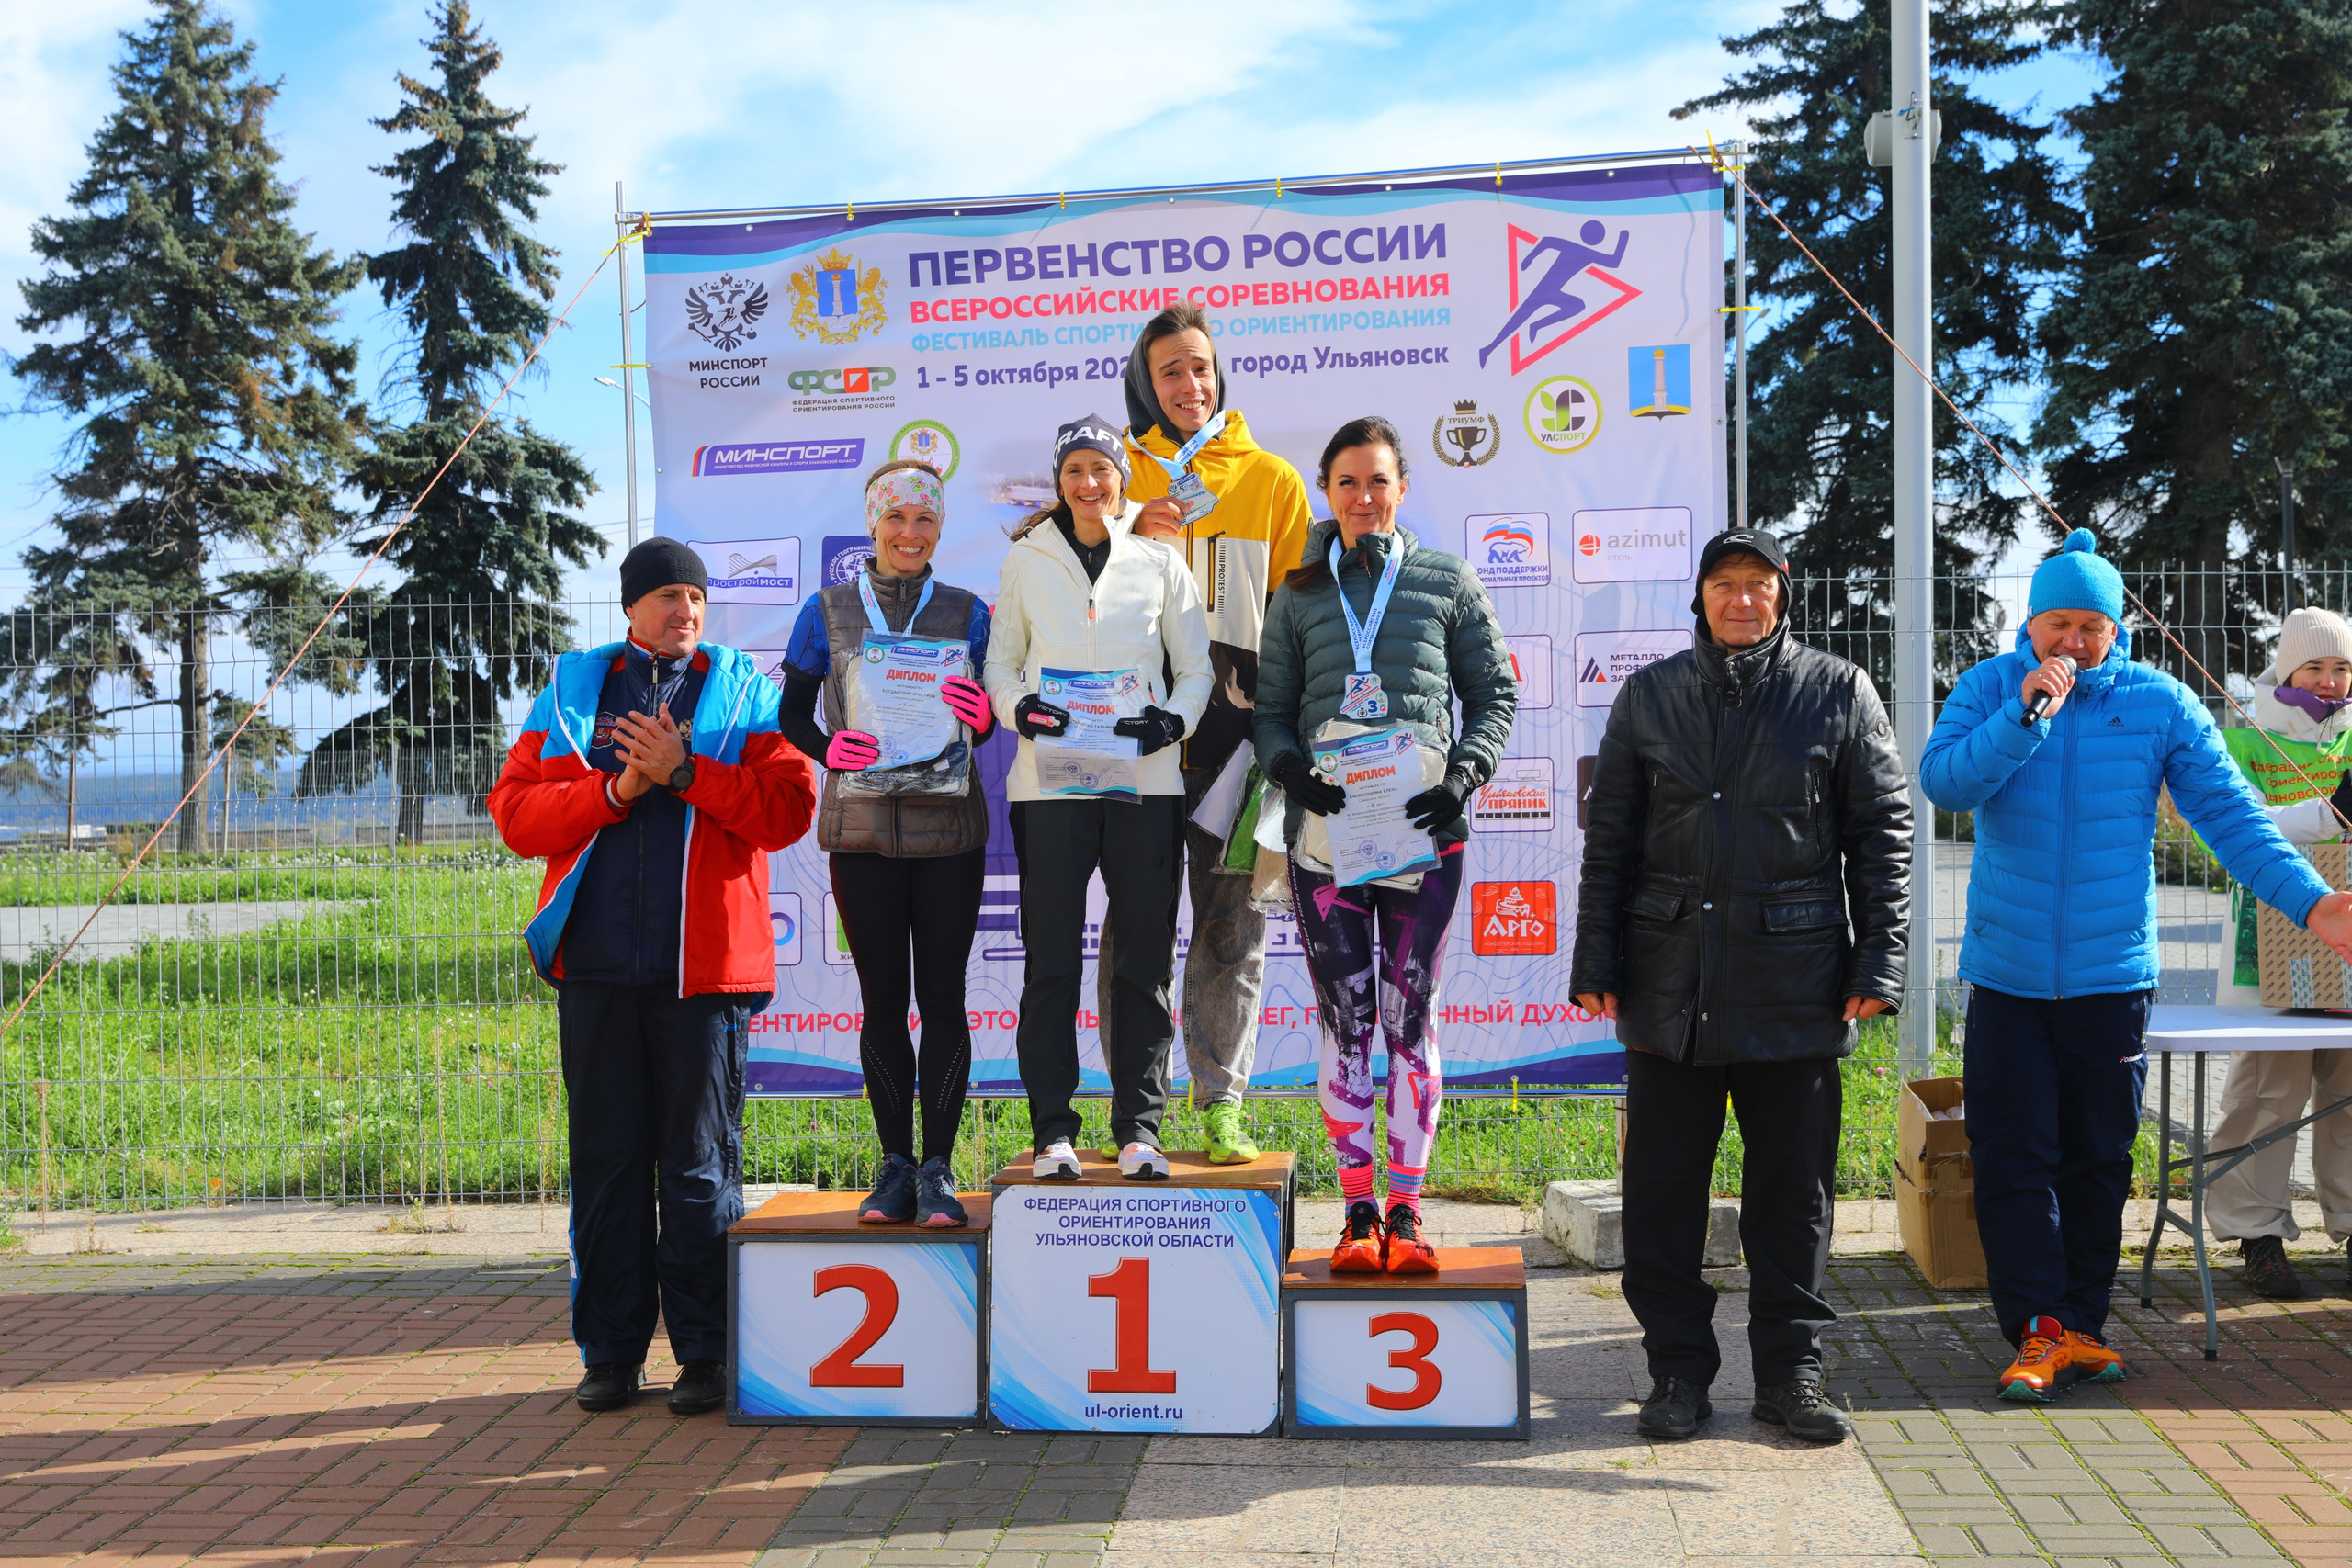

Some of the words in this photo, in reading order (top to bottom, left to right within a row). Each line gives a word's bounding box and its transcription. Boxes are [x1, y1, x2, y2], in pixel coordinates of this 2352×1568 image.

[908, 235, 1231, 288] ПЕРВЕНСТВО
[1243, 222, 1447, 269] РОССИИ
[910, 286, 1180, 324] ВСЕРОССИЙСКИЕ
[1187, 272, 1450, 309] СОРЕВНОВАНИЯ
[910, 326, 1050, 353] ФЕСТИВАЛЬ
[1228, 307, 1451, 337] ОРИЕНТИРОВАНИЯ
[688, 356, 768, 372] МИНСПОРТ
[917, 367, 930, 389] 1
[954, 365, 969, 387] 5
[975, 360, 1079, 389] октября
[1085, 355, 1130, 380] 202
[1231, 354, 1307, 378] город
[1313, 346, 1450, 370] Ульяновск
[699, 375, 760, 389] РОССИИ
[792, 398, 838, 406] ФЕДЕРАЦИЯ
[840, 395, 896, 403] СПОРТИВНОГО
[792, 403, 863, 412] ОРИЕНТИРОВАНИЯ
[1447, 416, 1485, 425] ТРИУМФ
[1540, 433, 1587, 443] УЛСПОРТ
[714, 444, 857, 464] МИНСПОРТ
[1607, 528, 1687, 548] azimut
[829, 555, 840, 581] РУССКОЕ
[837, 545, 875, 558] ГЕОГРАФИЧЕС
[1477, 566, 1496, 575] ОНД
[1496, 564, 1549, 575] ПОДДЕРЖКИ
[1217, 563, 1226, 594] PROTEST
[1518, 574, 1551, 582] ПРОЕКТОВ
[896, 646, 937, 655] МИНСПОРТ
[1610, 653, 1665, 661] МЕТАЛЛО
[886, 668, 937, 683] ДИПЛОМ
[1611, 664, 1645, 672] ПРОФ
[1037, 703, 1068, 716] VICTORY
[1066, 700, 1115, 716] ДИПЛОМ
[1367, 700, 1378, 713] 3
[1347, 740, 1387, 753] МИНСПОРТ
[1345, 764, 1396, 785] ДИПЛОМ
[1487, 797, 1548, 810] ПРЯНИК
[967, 1010, 1018, 1030] ЭТО
[1023, 1197, 1123, 1213] ФЕДЕРАЦИЯ
[1125, 1198, 1247, 1213] СПОРТИВНОГО
[1057, 1214, 1212, 1230] ОРИЕНТИРОВАНИЯ
[1035, 1231, 1156, 1247] УЛЬЯНОВСКОЙ
[1158, 1234, 1235, 1248] ОБЛАСТИ
[809, 1262, 905, 1389] 2
[1086, 1255, 1177, 1394] 1
[1366, 1311, 1442, 1411] 3
[1084, 1403, 1183, 1420] ul-orient.ru
